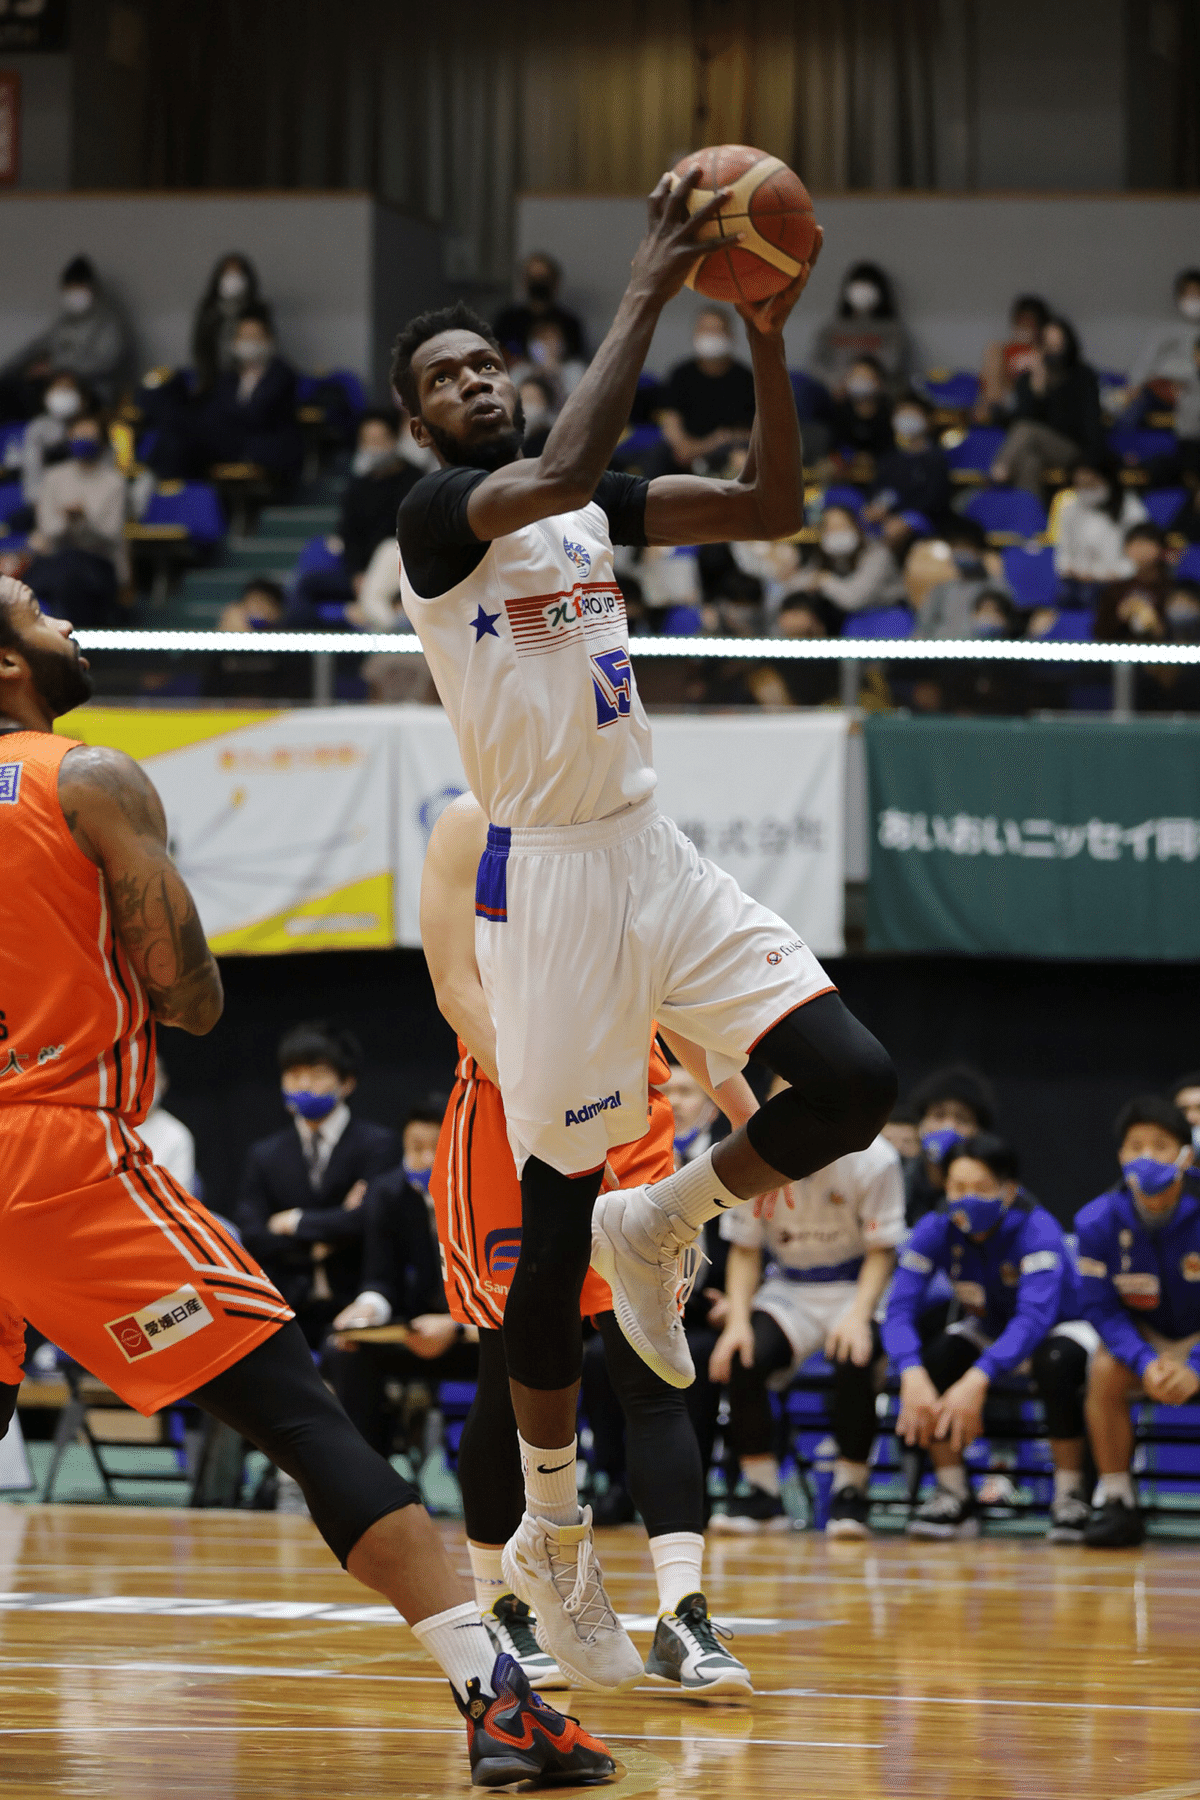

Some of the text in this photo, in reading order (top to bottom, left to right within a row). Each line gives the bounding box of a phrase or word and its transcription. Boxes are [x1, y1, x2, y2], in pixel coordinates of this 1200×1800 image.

[565, 1090, 622, 1127] Admiral
[144, 1297, 202, 1337] 愛媛日産
